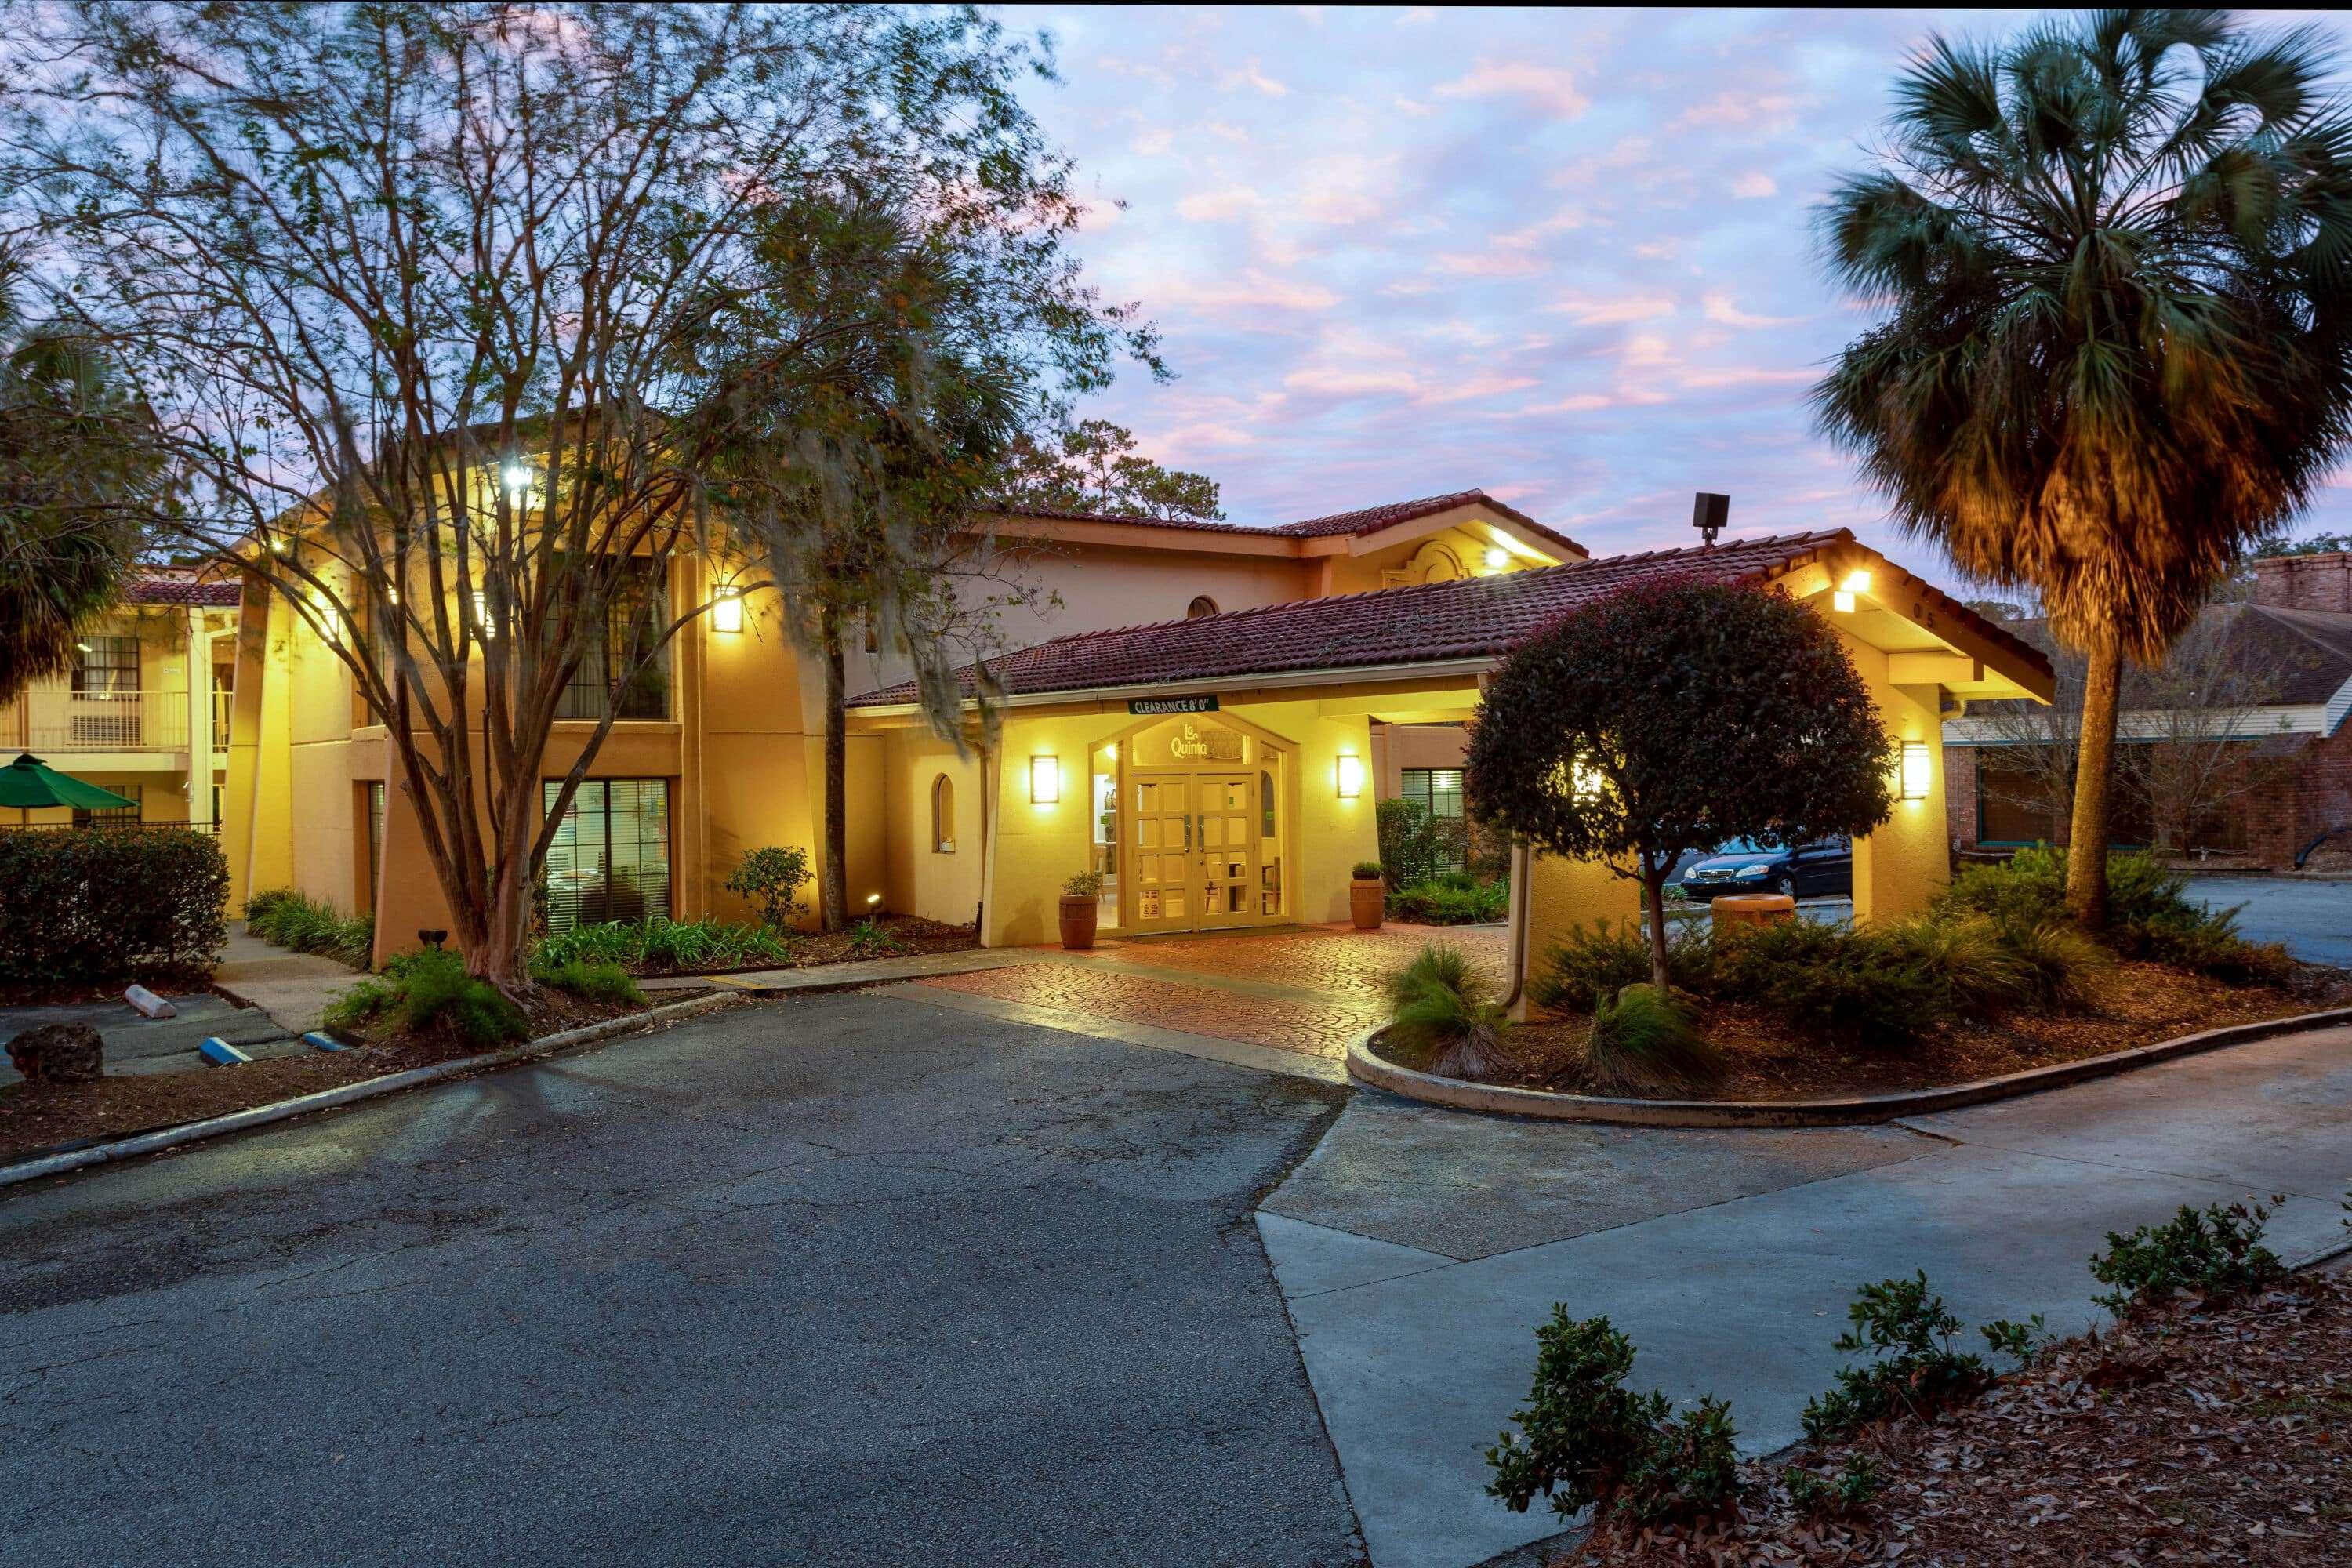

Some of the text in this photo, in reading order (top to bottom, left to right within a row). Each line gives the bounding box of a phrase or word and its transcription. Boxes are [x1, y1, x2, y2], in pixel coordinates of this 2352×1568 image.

[1134, 700, 1188, 713] CLEARANCE
[1184, 724, 1196, 741] La
[1171, 737, 1207, 759] Quinta
